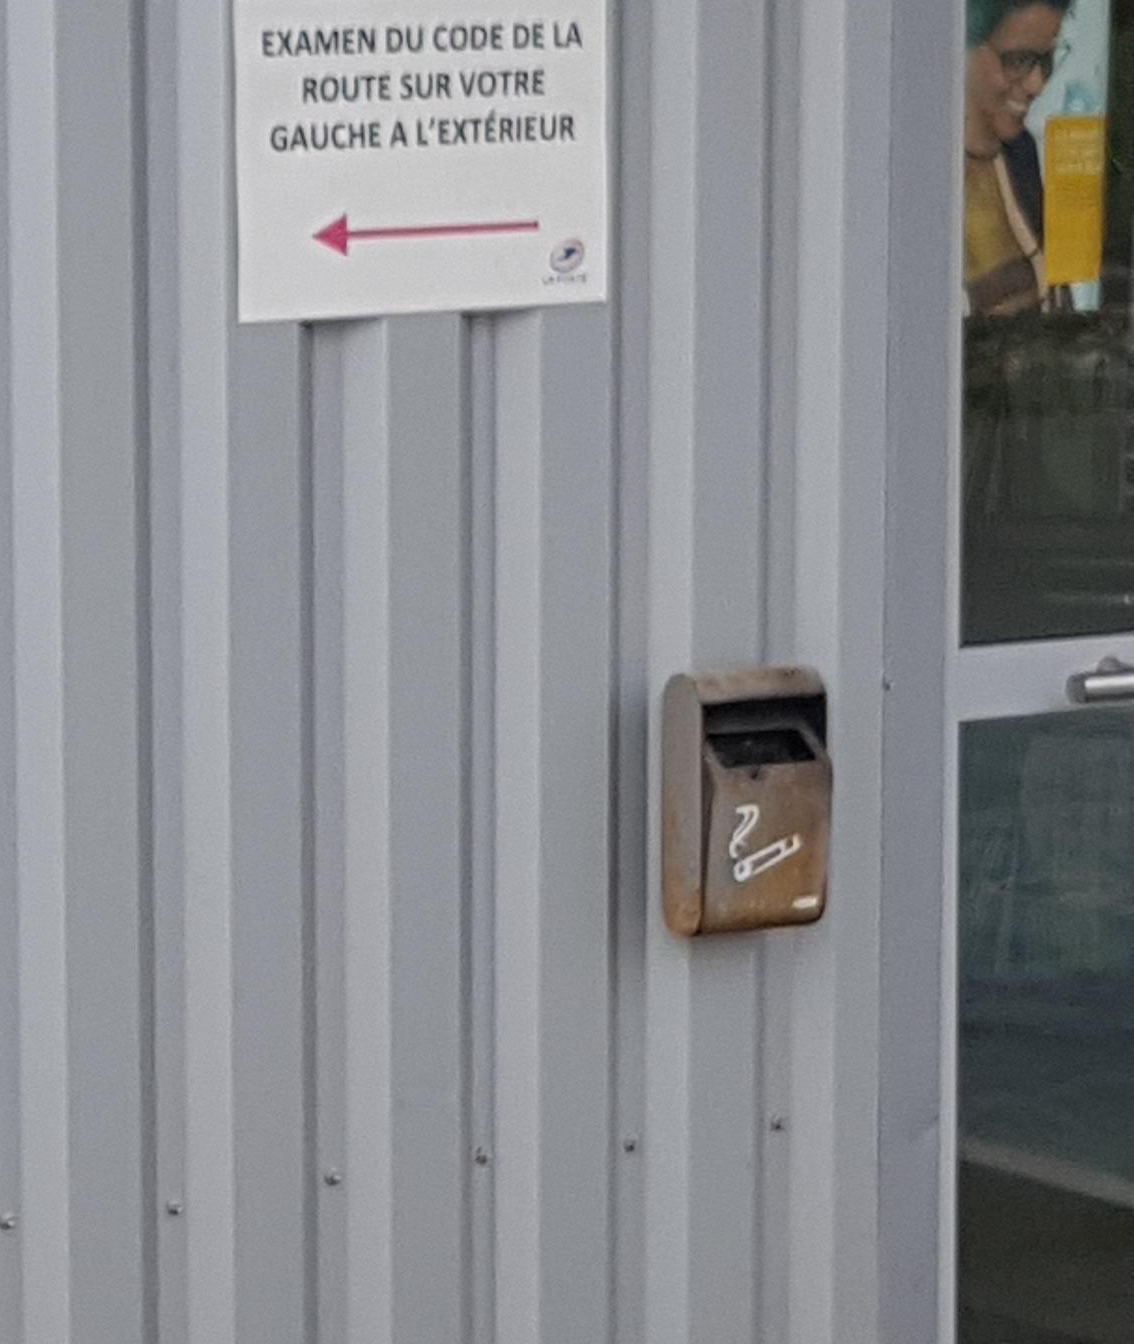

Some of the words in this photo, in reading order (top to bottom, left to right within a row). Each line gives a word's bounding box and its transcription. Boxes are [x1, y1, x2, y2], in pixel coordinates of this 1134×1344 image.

[262, 26, 376, 56] EXAMEN
[386, 27, 424, 52] DU
[433, 23, 503, 50] CODE
[513, 22, 545, 48] DE
[554, 22, 583, 48] LA
[302, 74, 391, 103] ROUTE
[399, 72, 451, 99] SUR
[460, 69, 545, 96] VOTRE
[270, 123, 381, 152] GAUCHE
[389, 121, 408, 147] A
